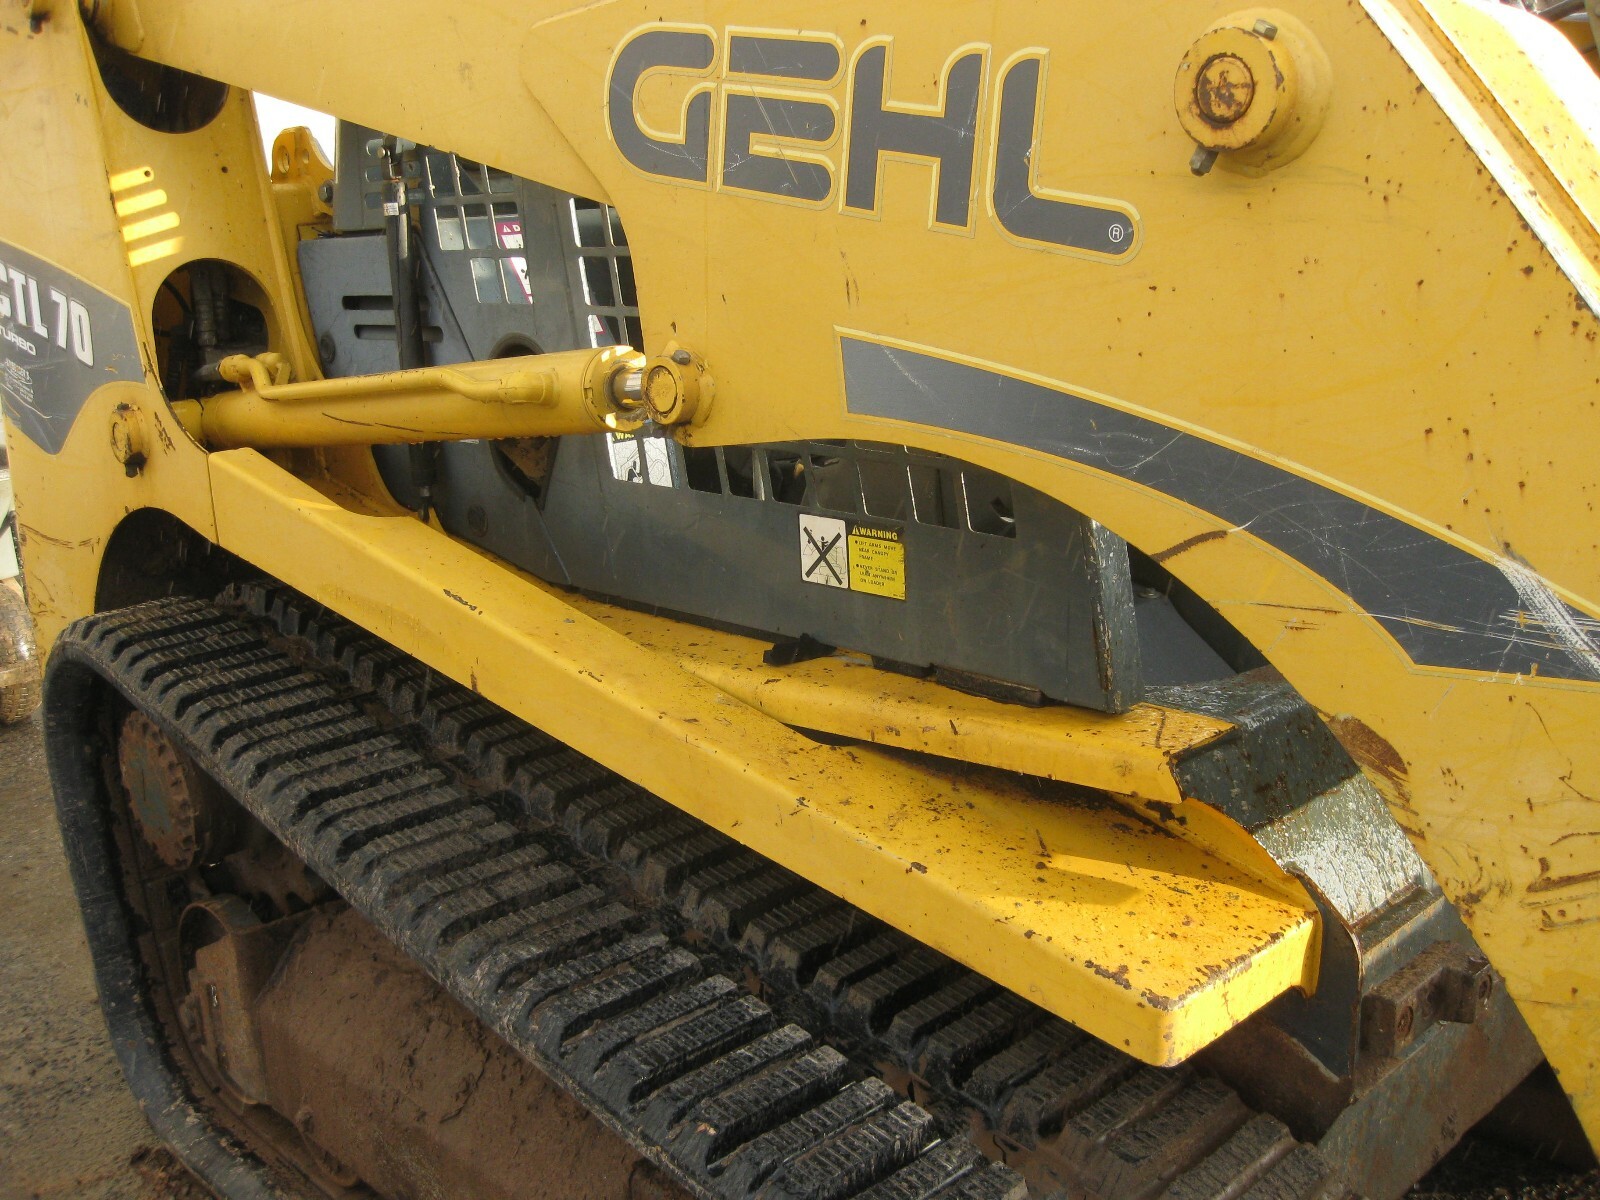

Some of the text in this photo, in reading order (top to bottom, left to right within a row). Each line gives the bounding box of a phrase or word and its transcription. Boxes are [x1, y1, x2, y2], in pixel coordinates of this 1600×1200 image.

[606, 25, 1140, 261] GEHL
[50, 287, 94, 367] 70
[859, 527, 898, 540] WARNING
